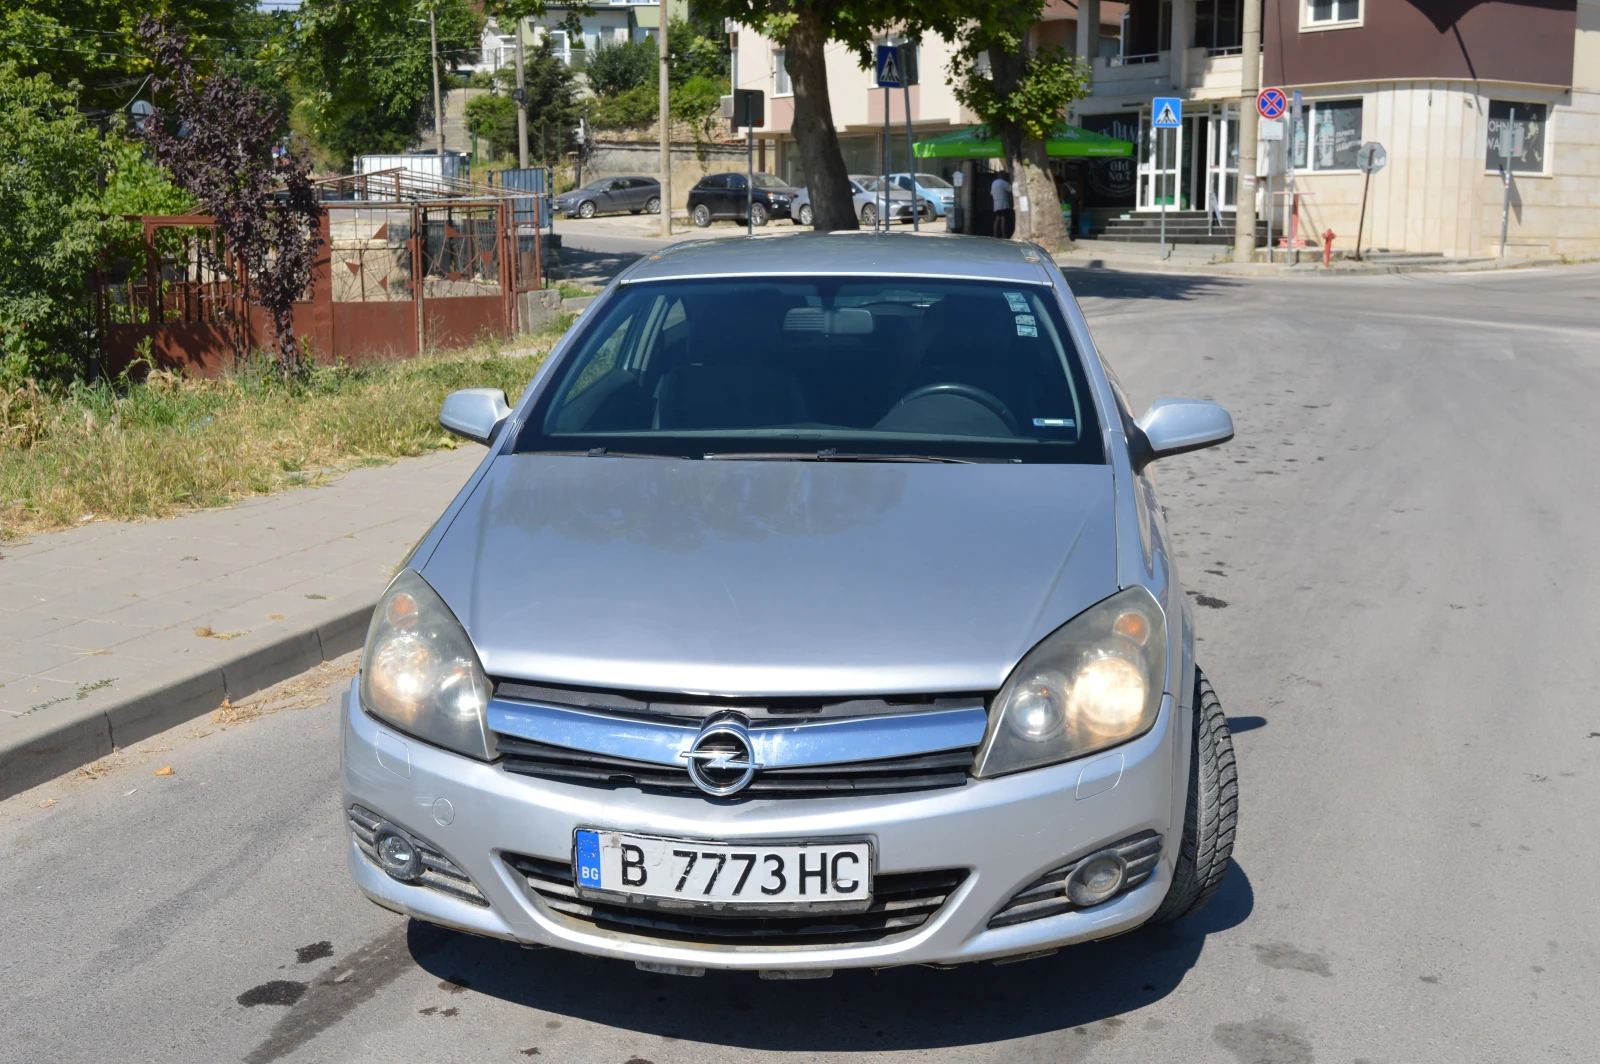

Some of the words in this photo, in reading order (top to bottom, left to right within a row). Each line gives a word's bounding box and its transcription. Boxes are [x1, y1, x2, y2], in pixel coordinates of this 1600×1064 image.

[1113, 120, 1139, 144] DAN
[1488, 121, 1524, 132] OHNIE
[1487, 137, 1501, 150] WA
[1110, 160, 1129, 171] Old
[581, 866, 599, 880] BG
[621, 843, 647, 887] B
[673, 850, 787, 896] 7773
[799, 851, 859, 894] HC
